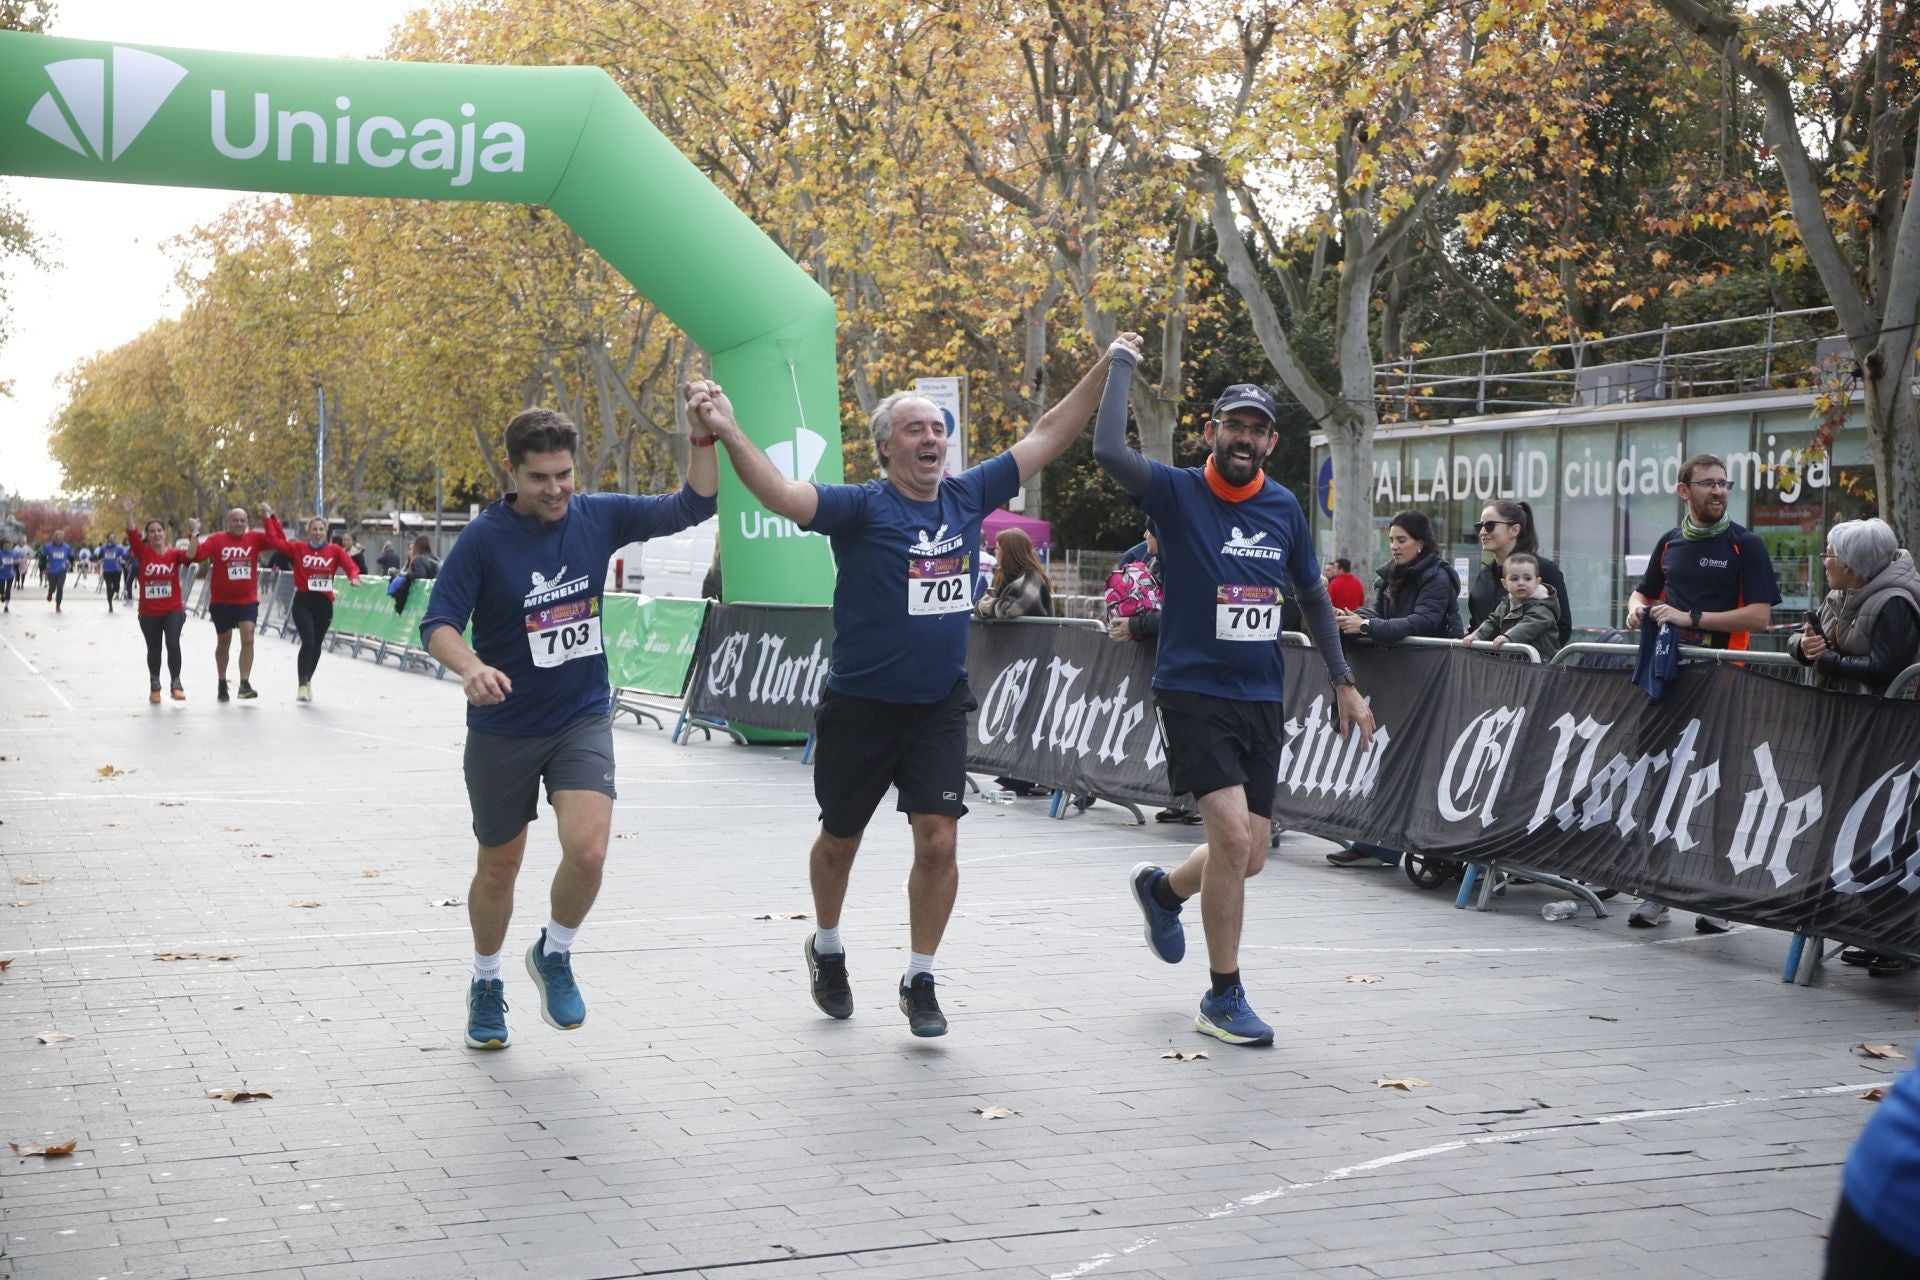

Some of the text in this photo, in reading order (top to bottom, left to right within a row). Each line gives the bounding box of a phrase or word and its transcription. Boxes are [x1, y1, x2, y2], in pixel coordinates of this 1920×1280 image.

[210, 88, 526, 187] Unicaja
[1371, 434, 1832, 504] ALLADOLID ciudad miga
[1220, 545, 1282, 560] MICHELIN
[231, 567, 249, 576] 415
[311, 580, 328, 588] 417
[148, 586, 168, 595] 416
[523, 580, 589, 608] MICHELIN
[920, 578, 964, 603] 702
[1228, 607, 1273, 630] 701
[540, 622, 590, 655] 703
[707, 630, 830, 707] El Norte
[977, 656, 1038, 745] El
[1031, 655, 1145, 767] Norte
[1437, 705, 1526, 828] El
[1526, 711, 1721, 853] Norte
[1725, 741, 1823, 888] de
